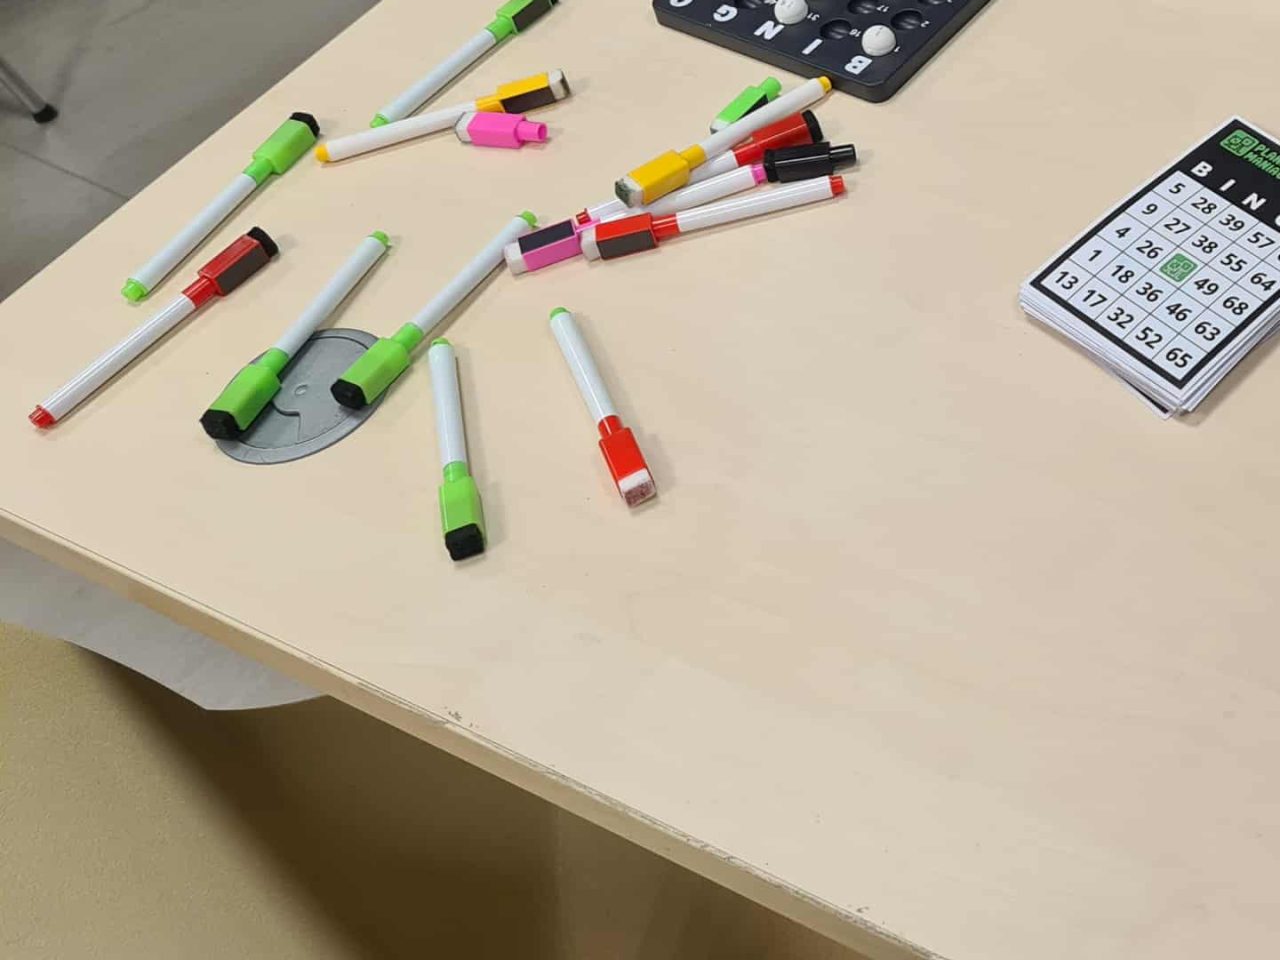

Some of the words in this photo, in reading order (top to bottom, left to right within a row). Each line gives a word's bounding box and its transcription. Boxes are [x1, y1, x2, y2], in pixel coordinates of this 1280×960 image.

[1142, 204, 1157, 214] 9
[1164, 218, 1190, 234] 27
[1192, 235, 1218, 253] 38
[1220, 254, 1247, 271] 55
[1251, 273, 1276, 291] 64
[1169, 183, 1185, 194] 5
[1192, 197, 1217, 214] 28
[1219, 214, 1244, 231] 39
[1248, 232, 1275, 248] 57
[1089, 250, 1101, 261] 1
[1112, 266, 1134, 283] 18
[1136, 282, 1162, 302] 36
[1166, 304, 1191, 321] 46
[1195, 322, 1220, 341] 63
[1116, 228, 1130, 238] 4
[1136, 240, 1163, 258] 26
[1194, 279, 1218, 295] 49
[1223, 297, 1248, 315] 68
[1056, 272, 1078, 289] 13
[1083, 290, 1107, 306] 17
[1108, 308, 1134, 328] 32
[1136, 327, 1162, 349] 52
[1166, 348, 1192, 368] 65
